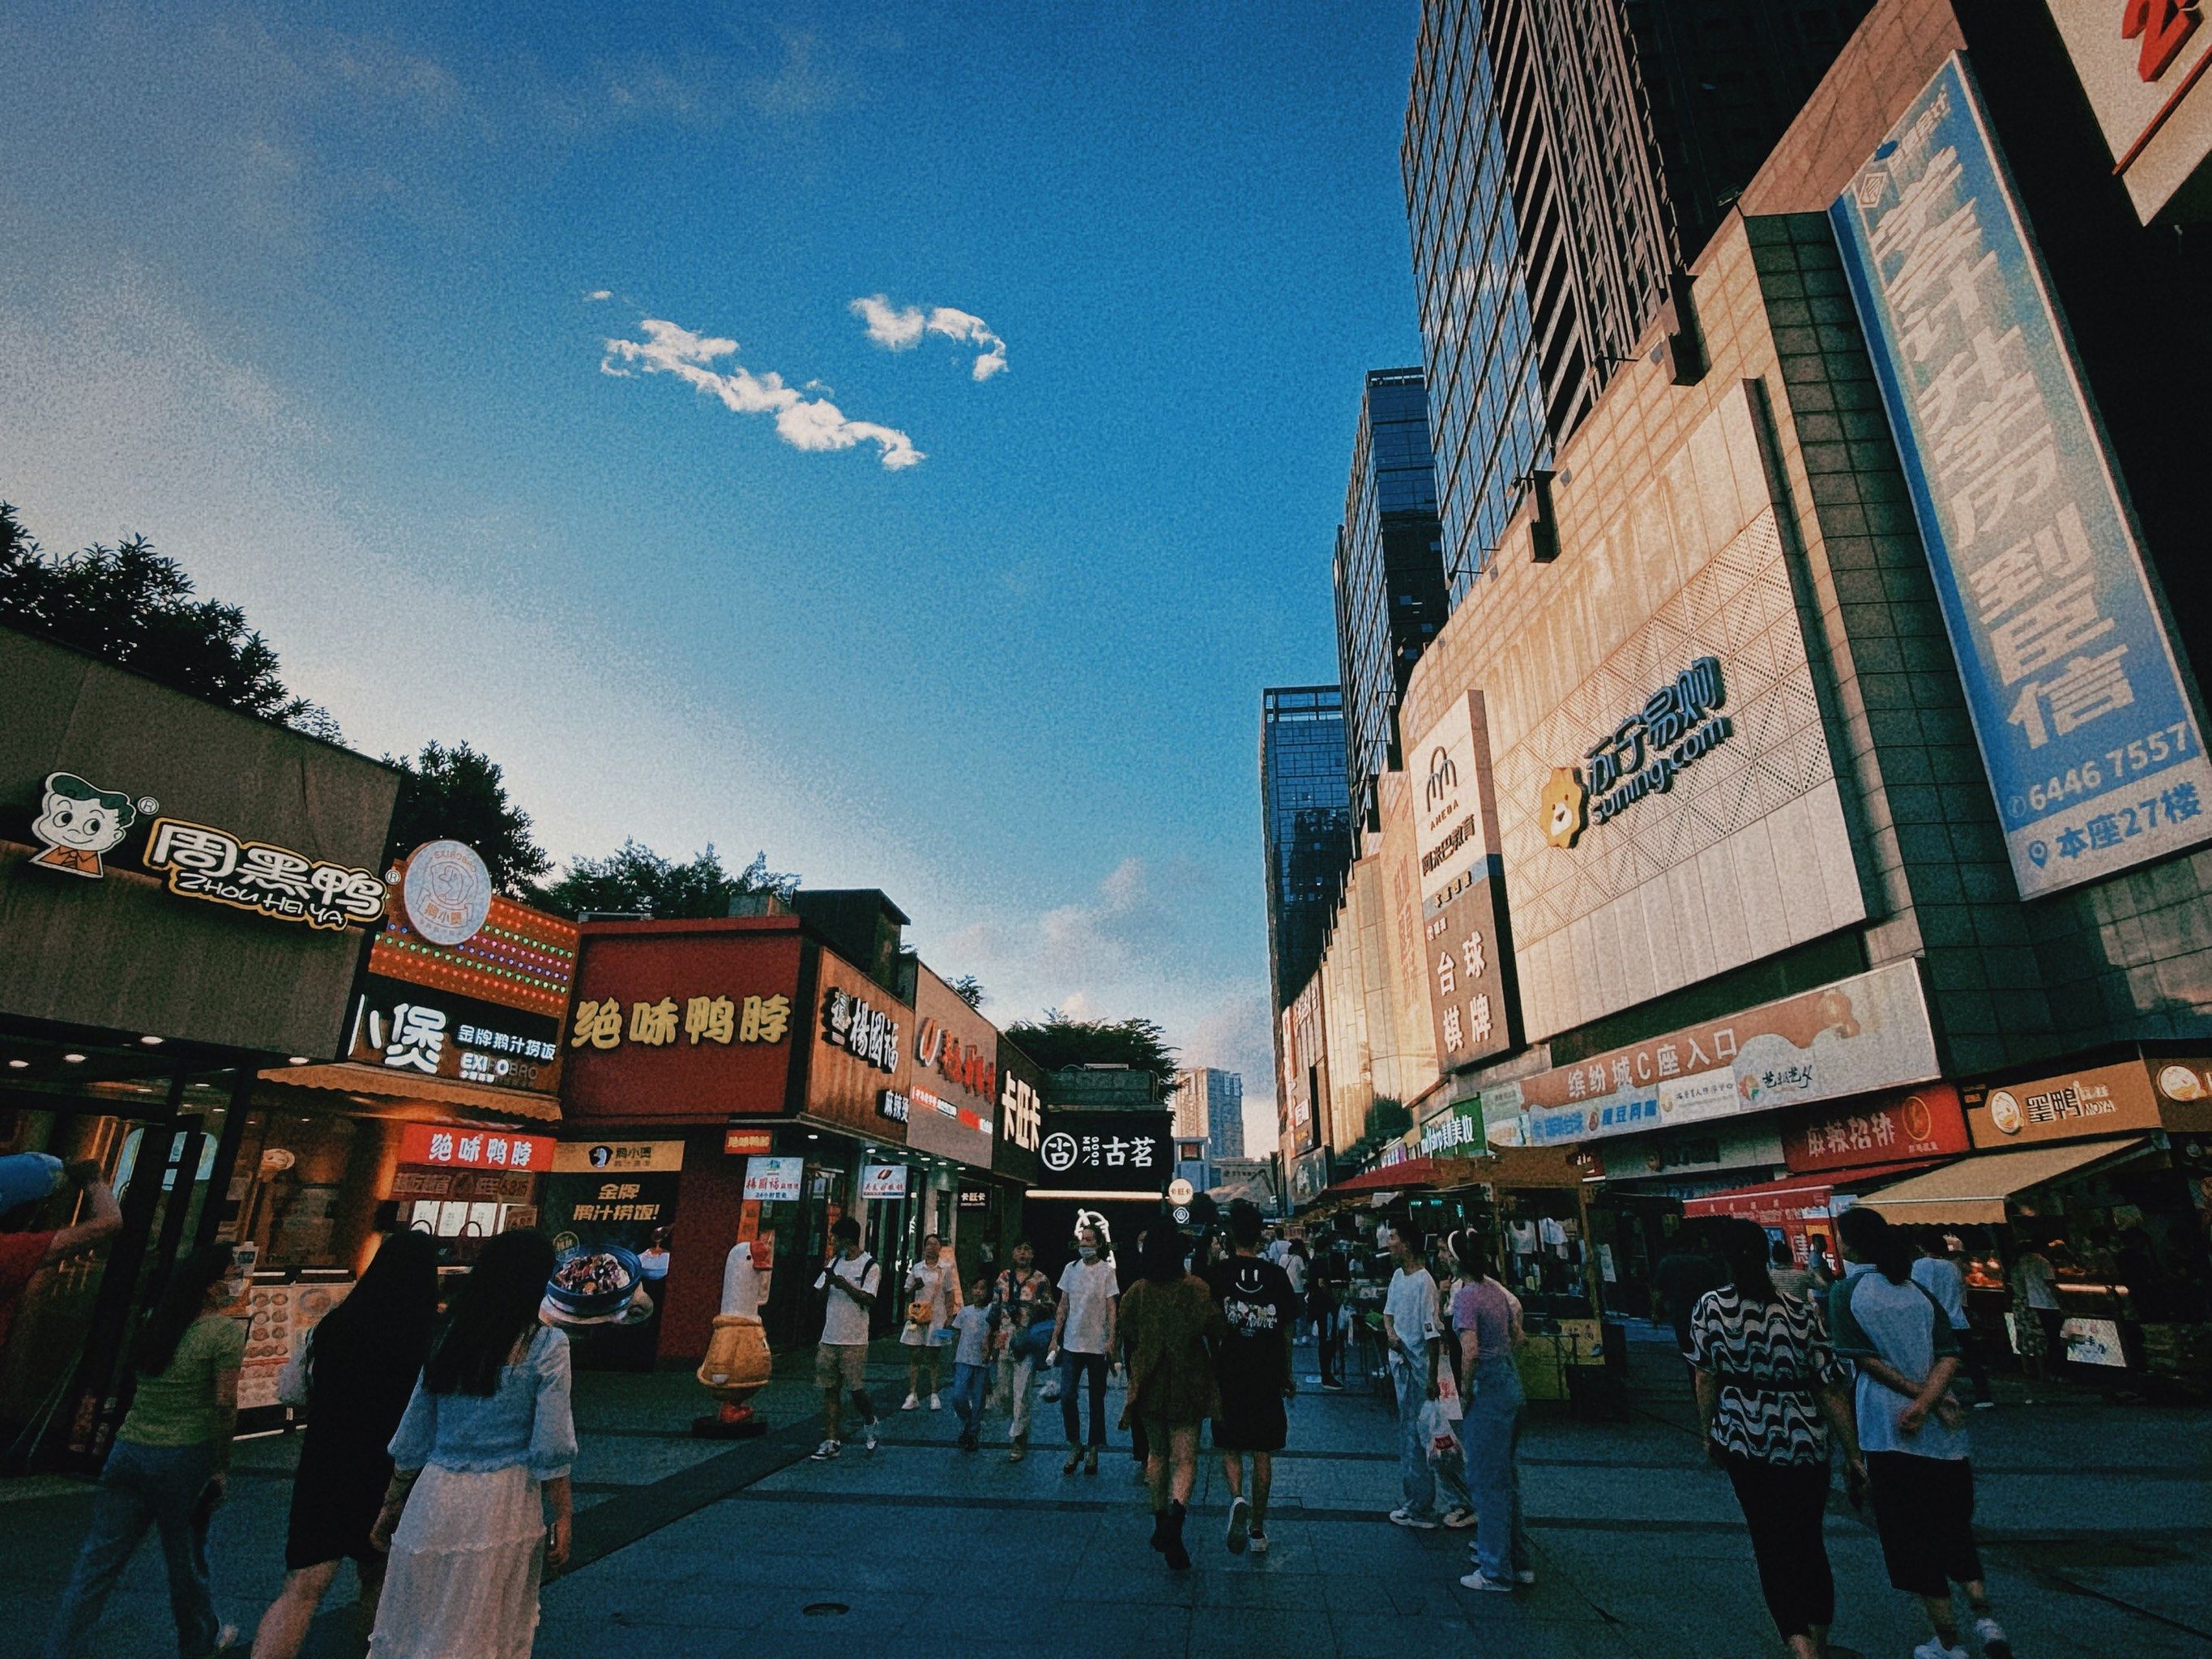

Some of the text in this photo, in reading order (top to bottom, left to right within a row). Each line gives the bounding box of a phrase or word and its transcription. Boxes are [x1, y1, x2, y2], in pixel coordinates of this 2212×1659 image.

[1584, 656, 1725, 797] 苏宁易购
[1591, 716, 1731, 825] suning.com
[2029, 721, 2189, 812] 6446 7557
[1422, 812, 1475, 876] 阿米巴教育
[1431, 799, 1458, 830] AMEBA
[2056, 782, 2202, 861] 本座27楼
[151, 824, 386, 915] 周黑鸭
[176, 872, 344, 925] ZHOU HEI YA
[571, 993, 791, 1050] 绝味鸭脖
[1567, 1028, 1738, 1098] 缤纷城C座入口
[2084, 1100, 2117, 1117] MOYA
[428, 1132, 533, 1166] 绝味鸭脖
[1102, 1136, 1155, 1167] 古茗
[598, 1183, 640, 1200] 金牌
